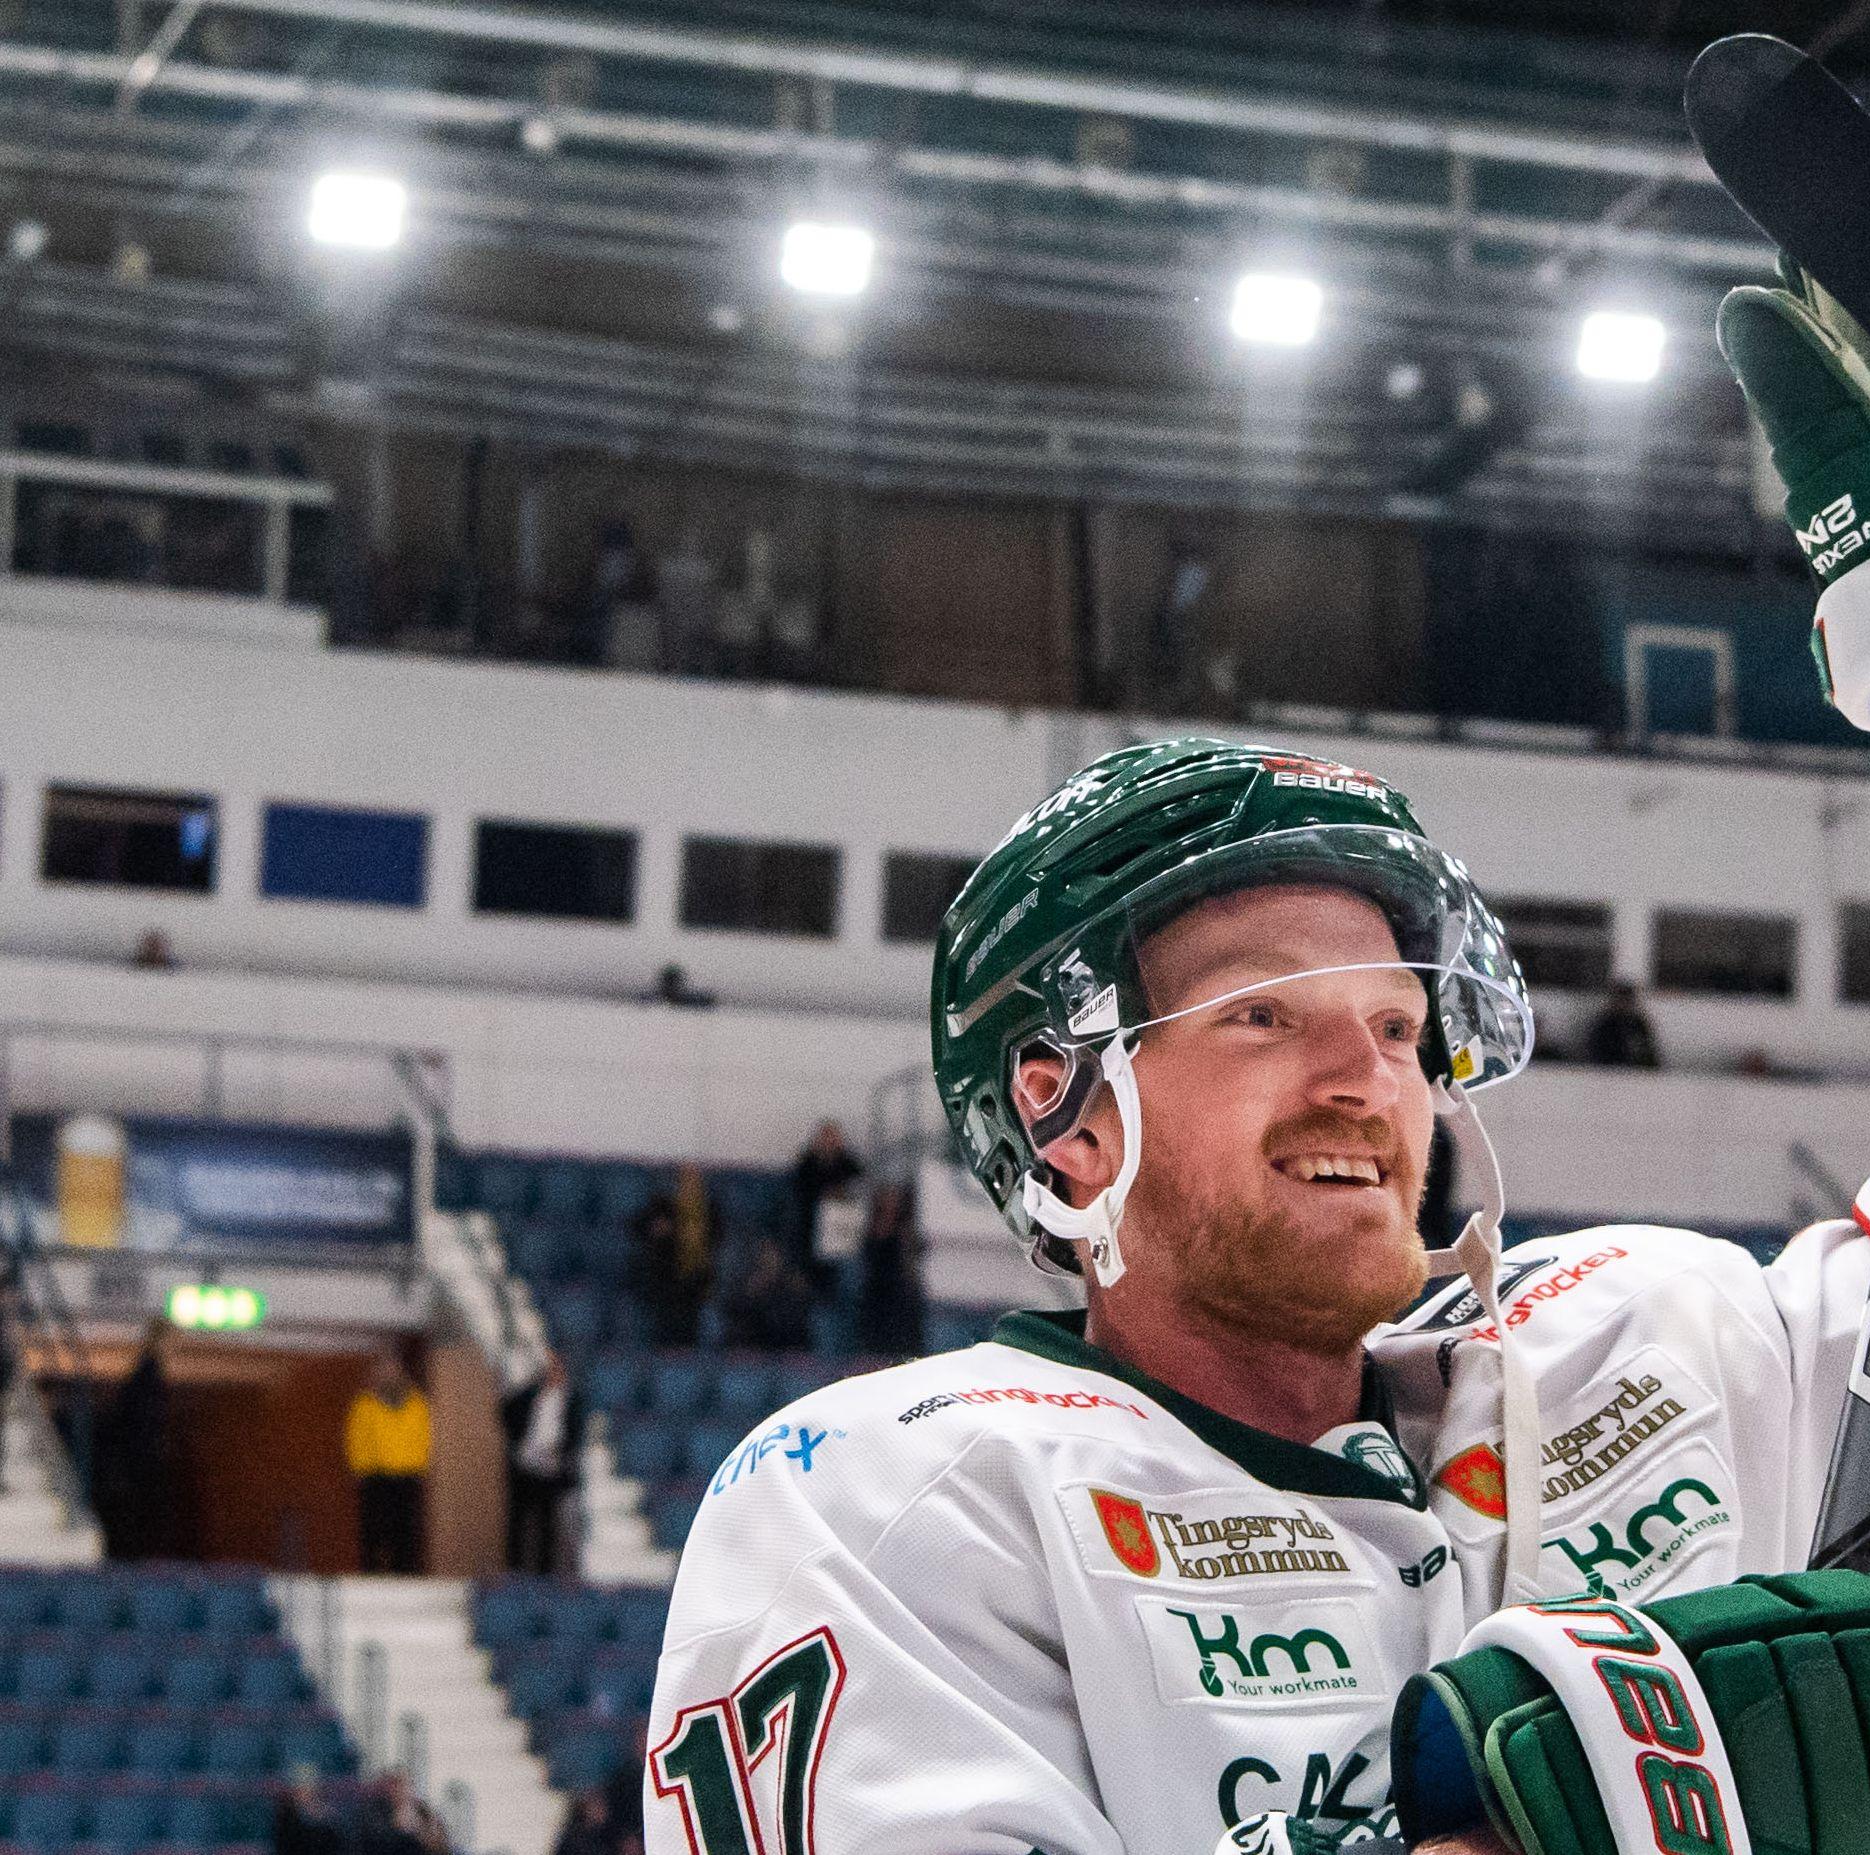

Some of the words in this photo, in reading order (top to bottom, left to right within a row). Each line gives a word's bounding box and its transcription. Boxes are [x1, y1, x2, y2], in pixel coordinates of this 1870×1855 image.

[1273, 771, 1388, 803] BAUER
[1073, 988, 1114, 1028] BAUER
[1147, 1508, 1335, 1550] Tingsryds
[1167, 1545, 1351, 1580] kommun
[1617, 1566, 1657, 1591] Your
[1658, 1511, 1730, 1563] workmate
[1228, 1680, 1263, 1696] Your
[1269, 1676, 1357, 1695] workmate
[650, 1625, 847, 1855] 17
